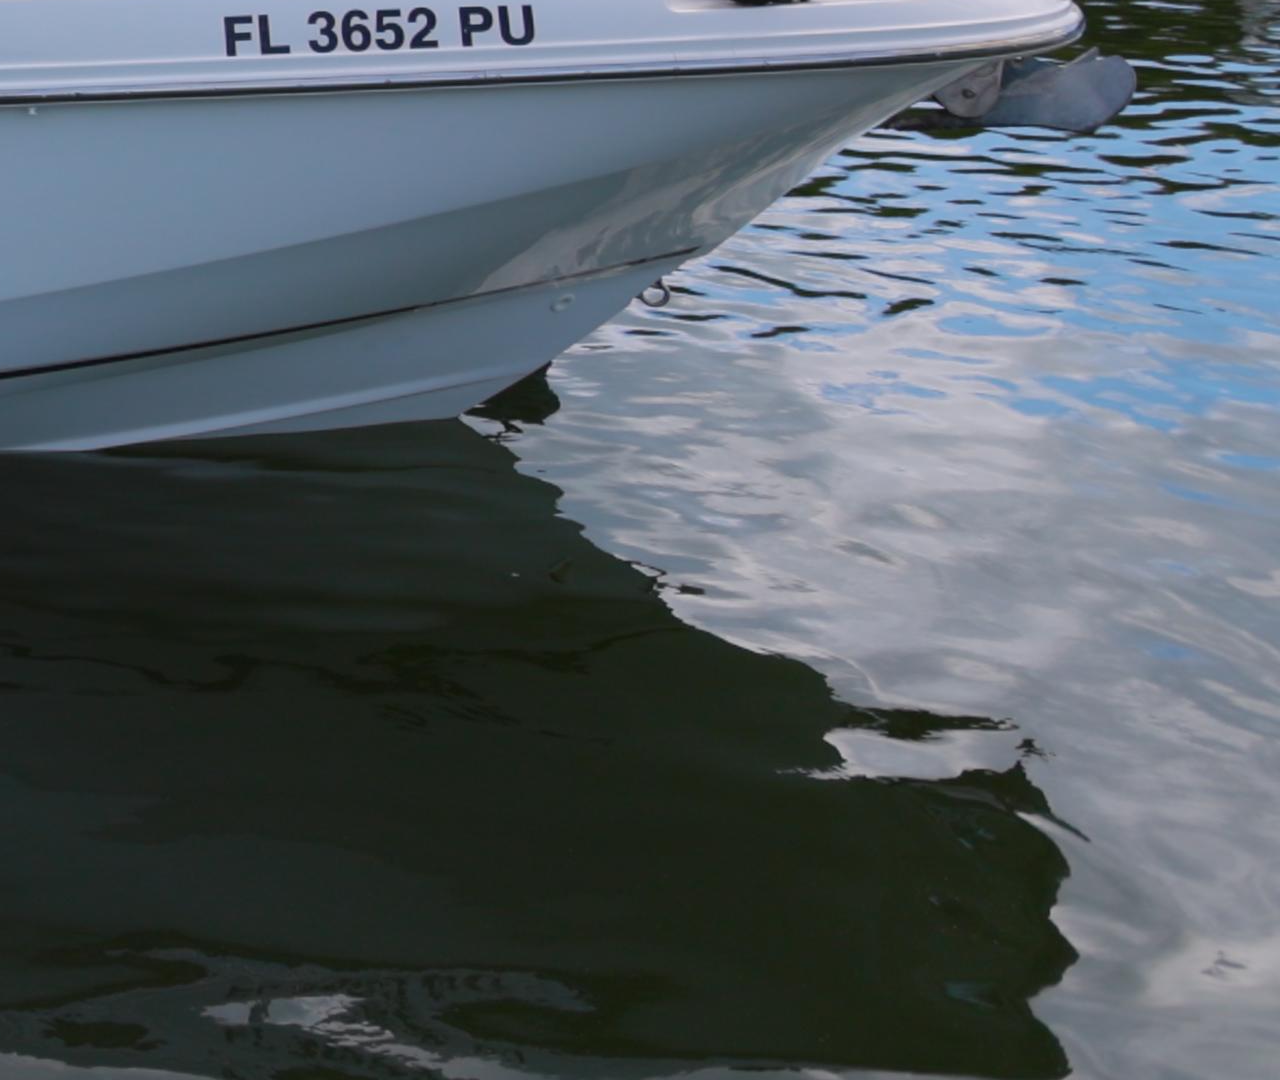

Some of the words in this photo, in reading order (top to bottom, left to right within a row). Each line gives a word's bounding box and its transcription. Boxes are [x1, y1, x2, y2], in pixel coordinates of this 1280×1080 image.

[224, 14, 291, 57] FL
[307, 6, 439, 53] 3652
[458, 4, 535, 47] PU
